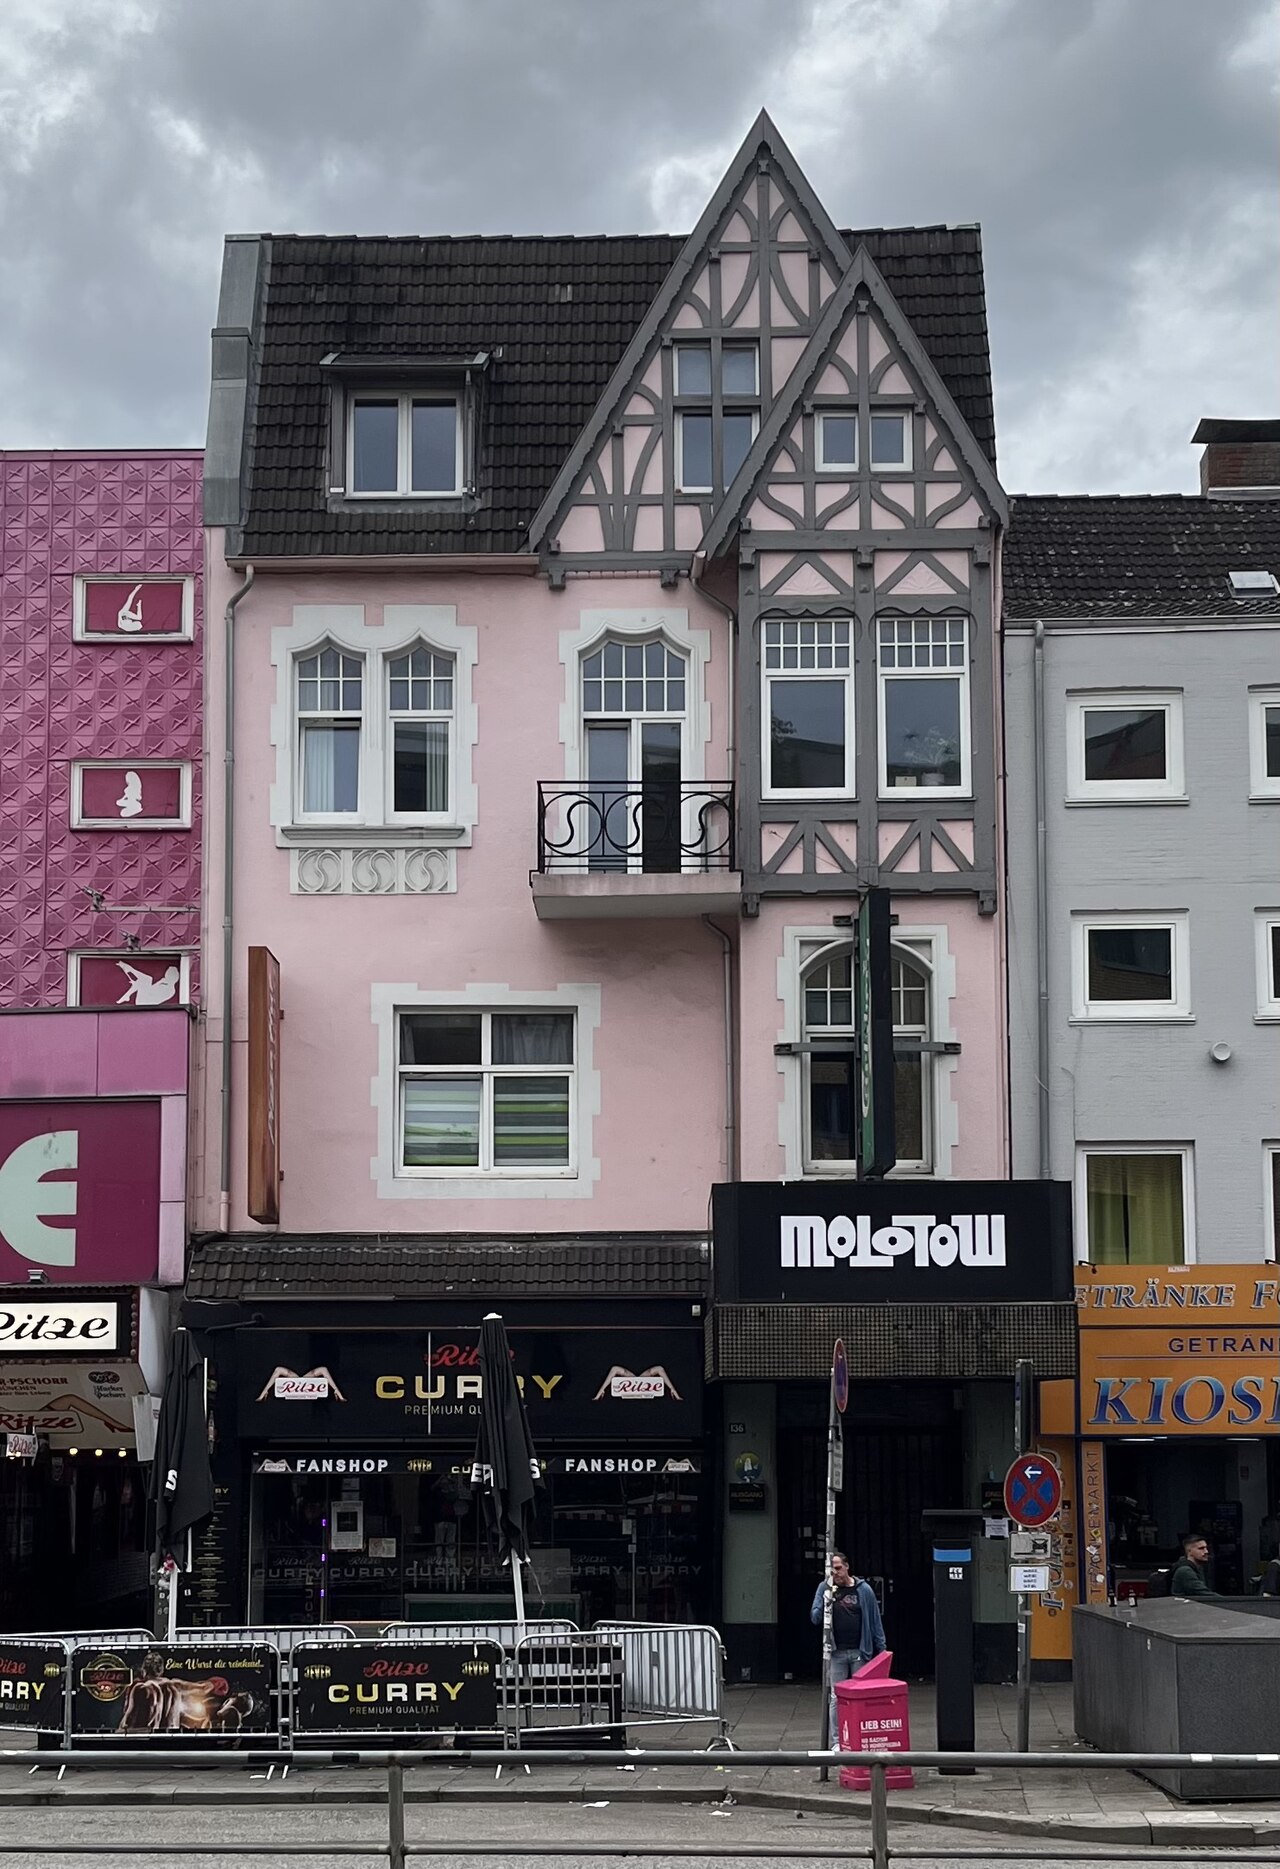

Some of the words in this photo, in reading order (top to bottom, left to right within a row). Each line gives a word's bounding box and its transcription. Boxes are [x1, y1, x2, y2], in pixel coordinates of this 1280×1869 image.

[780, 1214, 1006, 1267] MOLOTOW
[1250, 1279, 1280, 1310] F
[1169, 1334, 1280, 1353] GETRÄN
[281, 1380, 327, 1393] Ritze
[617, 1380, 662, 1393] Ritze
[404, 1404, 463, 1415] PREMIUM
[730, 1424, 744, 1433] 136
[296, 1459, 389, 1472] FANSHOP
[565, 1458, 657, 1472] FANSHOP
[329, 1568, 398, 1578] CURRY
[636, 1565, 702, 1575] CURRY
[303, 1664, 332, 1679] JEVER
[364, 1659, 429, 1678] Ritze
[462, 1661, 490, 1676] JEVER
[328, 1682, 465, 1703] CURRY
[350, 1706, 393, 1715] PREMIUM
[860, 1720, 879, 1730] LIEB
[880, 1718, 902, 1729] SEIN!
